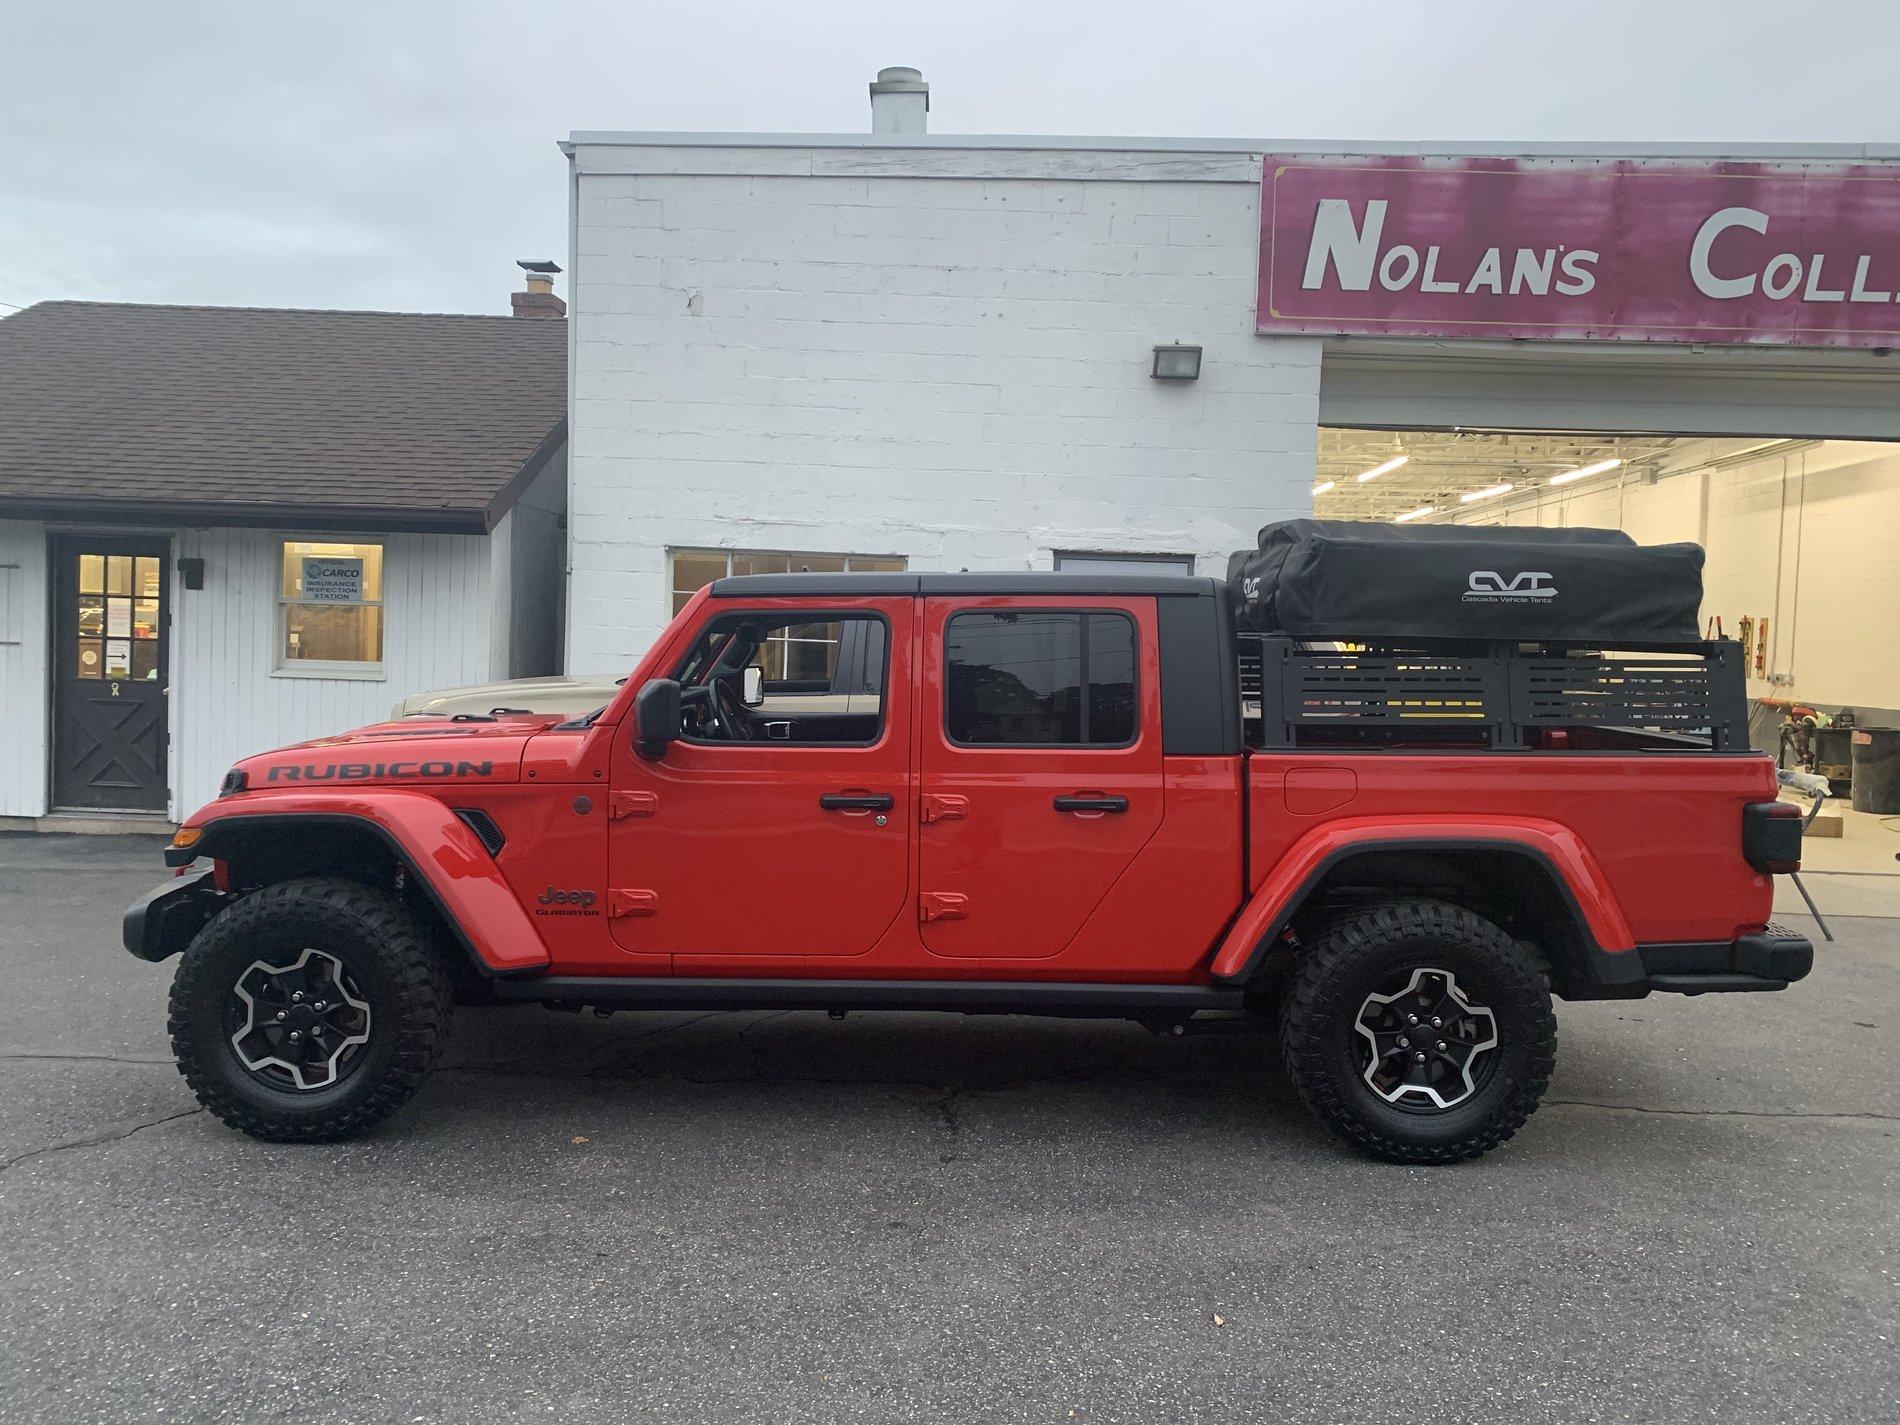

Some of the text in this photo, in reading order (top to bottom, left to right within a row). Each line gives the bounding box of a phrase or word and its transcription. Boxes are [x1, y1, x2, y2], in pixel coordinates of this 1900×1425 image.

[1689, 206, 1900, 303] COLL
[322, 569, 360, 577] CARCO
[1461, 595, 1553, 604] Cascadia Vehicle Tents
[268, 761, 493, 781] RUBICON
[538, 884, 597, 909] Jeep
[535, 909, 600, 917] GLADIATOR
